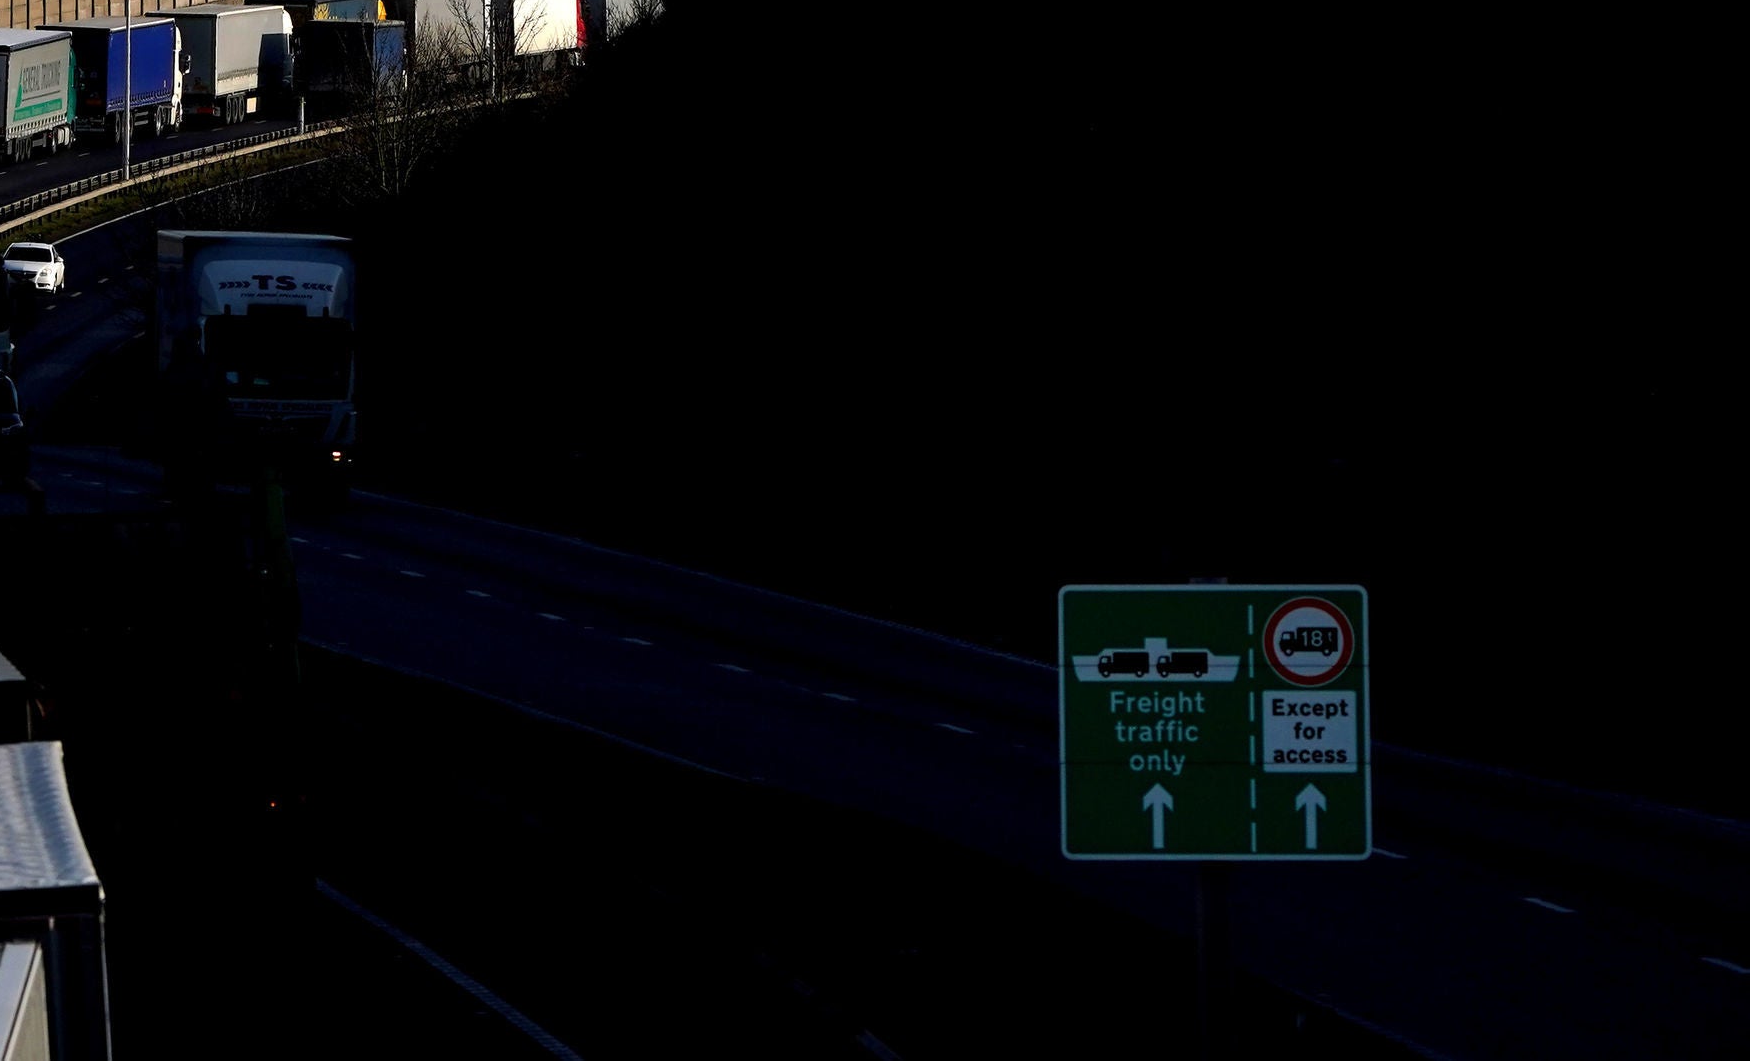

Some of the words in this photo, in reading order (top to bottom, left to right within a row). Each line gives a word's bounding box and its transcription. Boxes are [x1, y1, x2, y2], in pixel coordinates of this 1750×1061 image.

[252, 275, 297, 291] TS
[1109, 690, 1206, 718] Freight
[1271, 698, 1349, 720] Except
[1114, 720, 1200, 743] traffic
[1293, 722, 1326, 740] for
[1129, 748, 1187, 776] only
[1273, 748, 1347, 764] access
